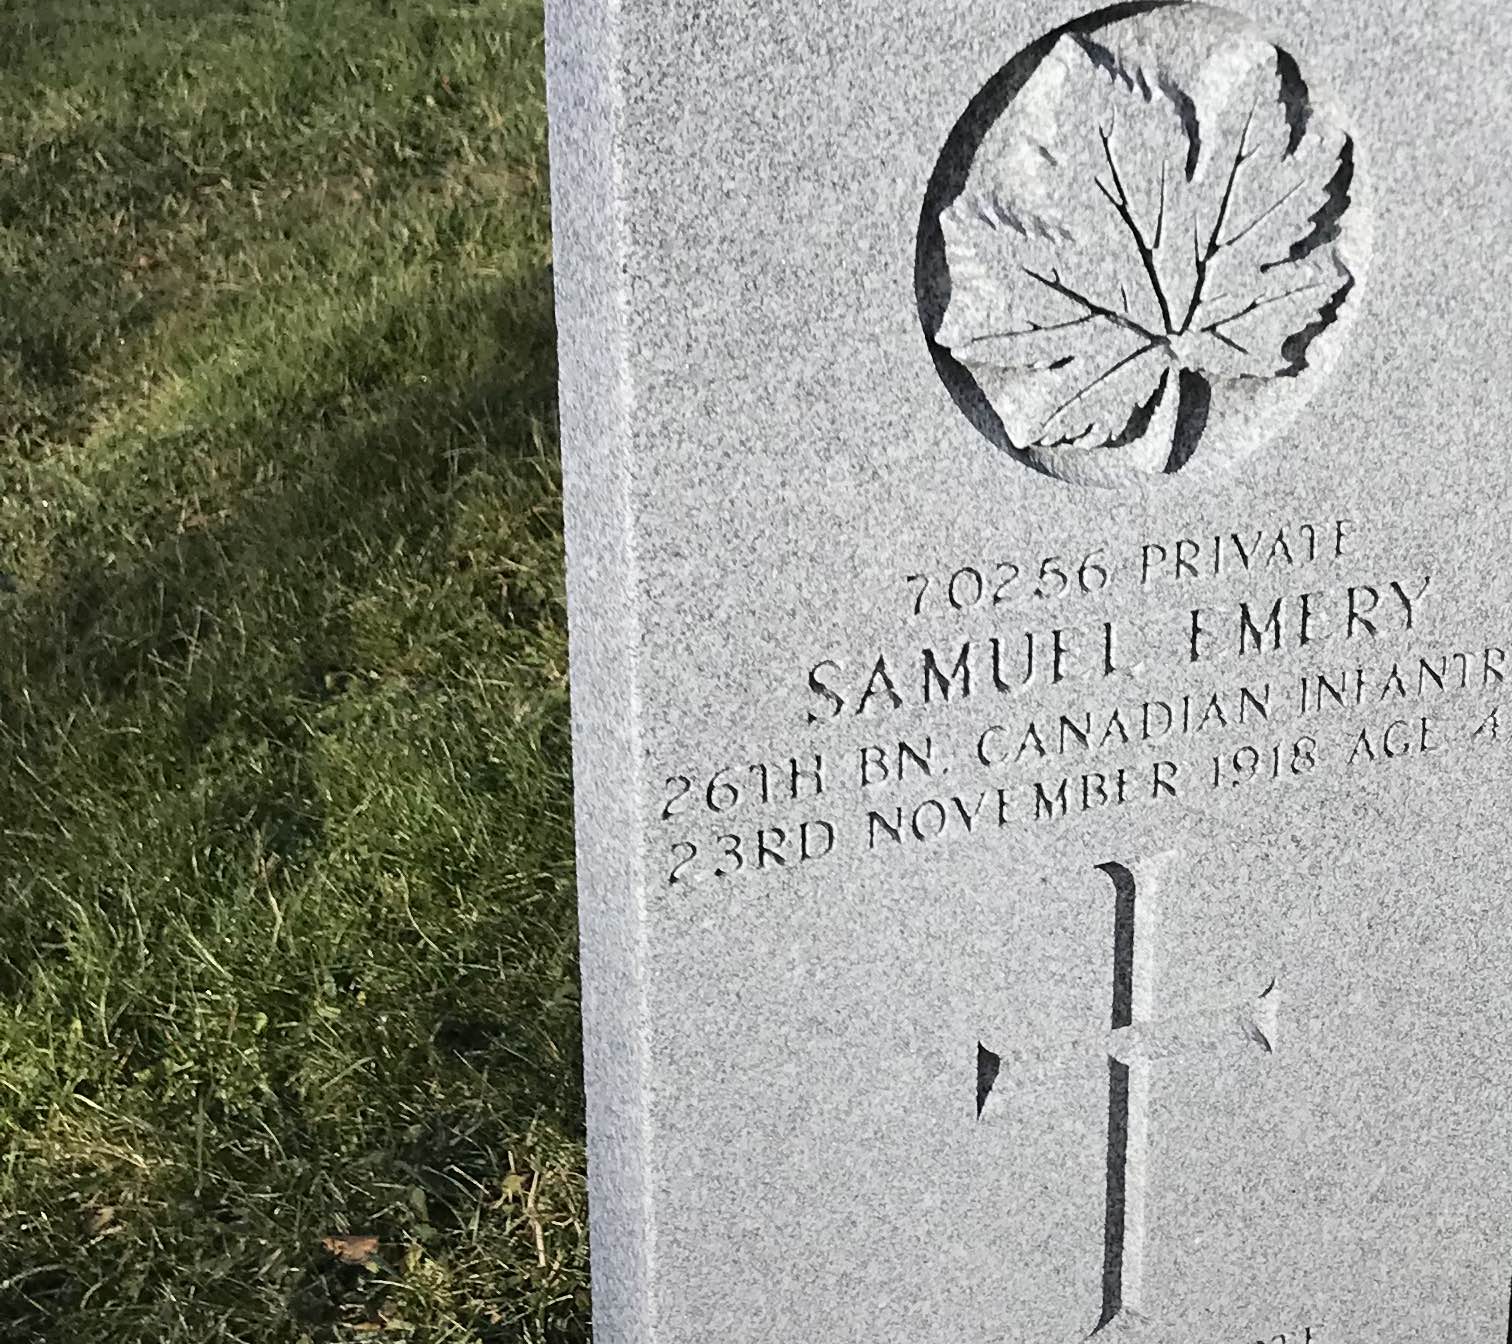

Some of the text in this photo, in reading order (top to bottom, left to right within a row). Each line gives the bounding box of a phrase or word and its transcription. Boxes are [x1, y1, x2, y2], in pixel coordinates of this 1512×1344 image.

[905, 519, 1354, 615] 70256 PRIVATE
[807, 575, 1432, 725] SAMUEL EMERY
[661, 755, 826, 821] 26TH
[860, 736, 950, 788] BN.
[976, 683, 1269, 767] CANADIAN
[668, 819, 836, 885] 23RD
[868, 760, 1178, 849] NOVEMBER
[1213, 735, 1319, 788] 1918
[1349, 717, 1442, 765] AGE
